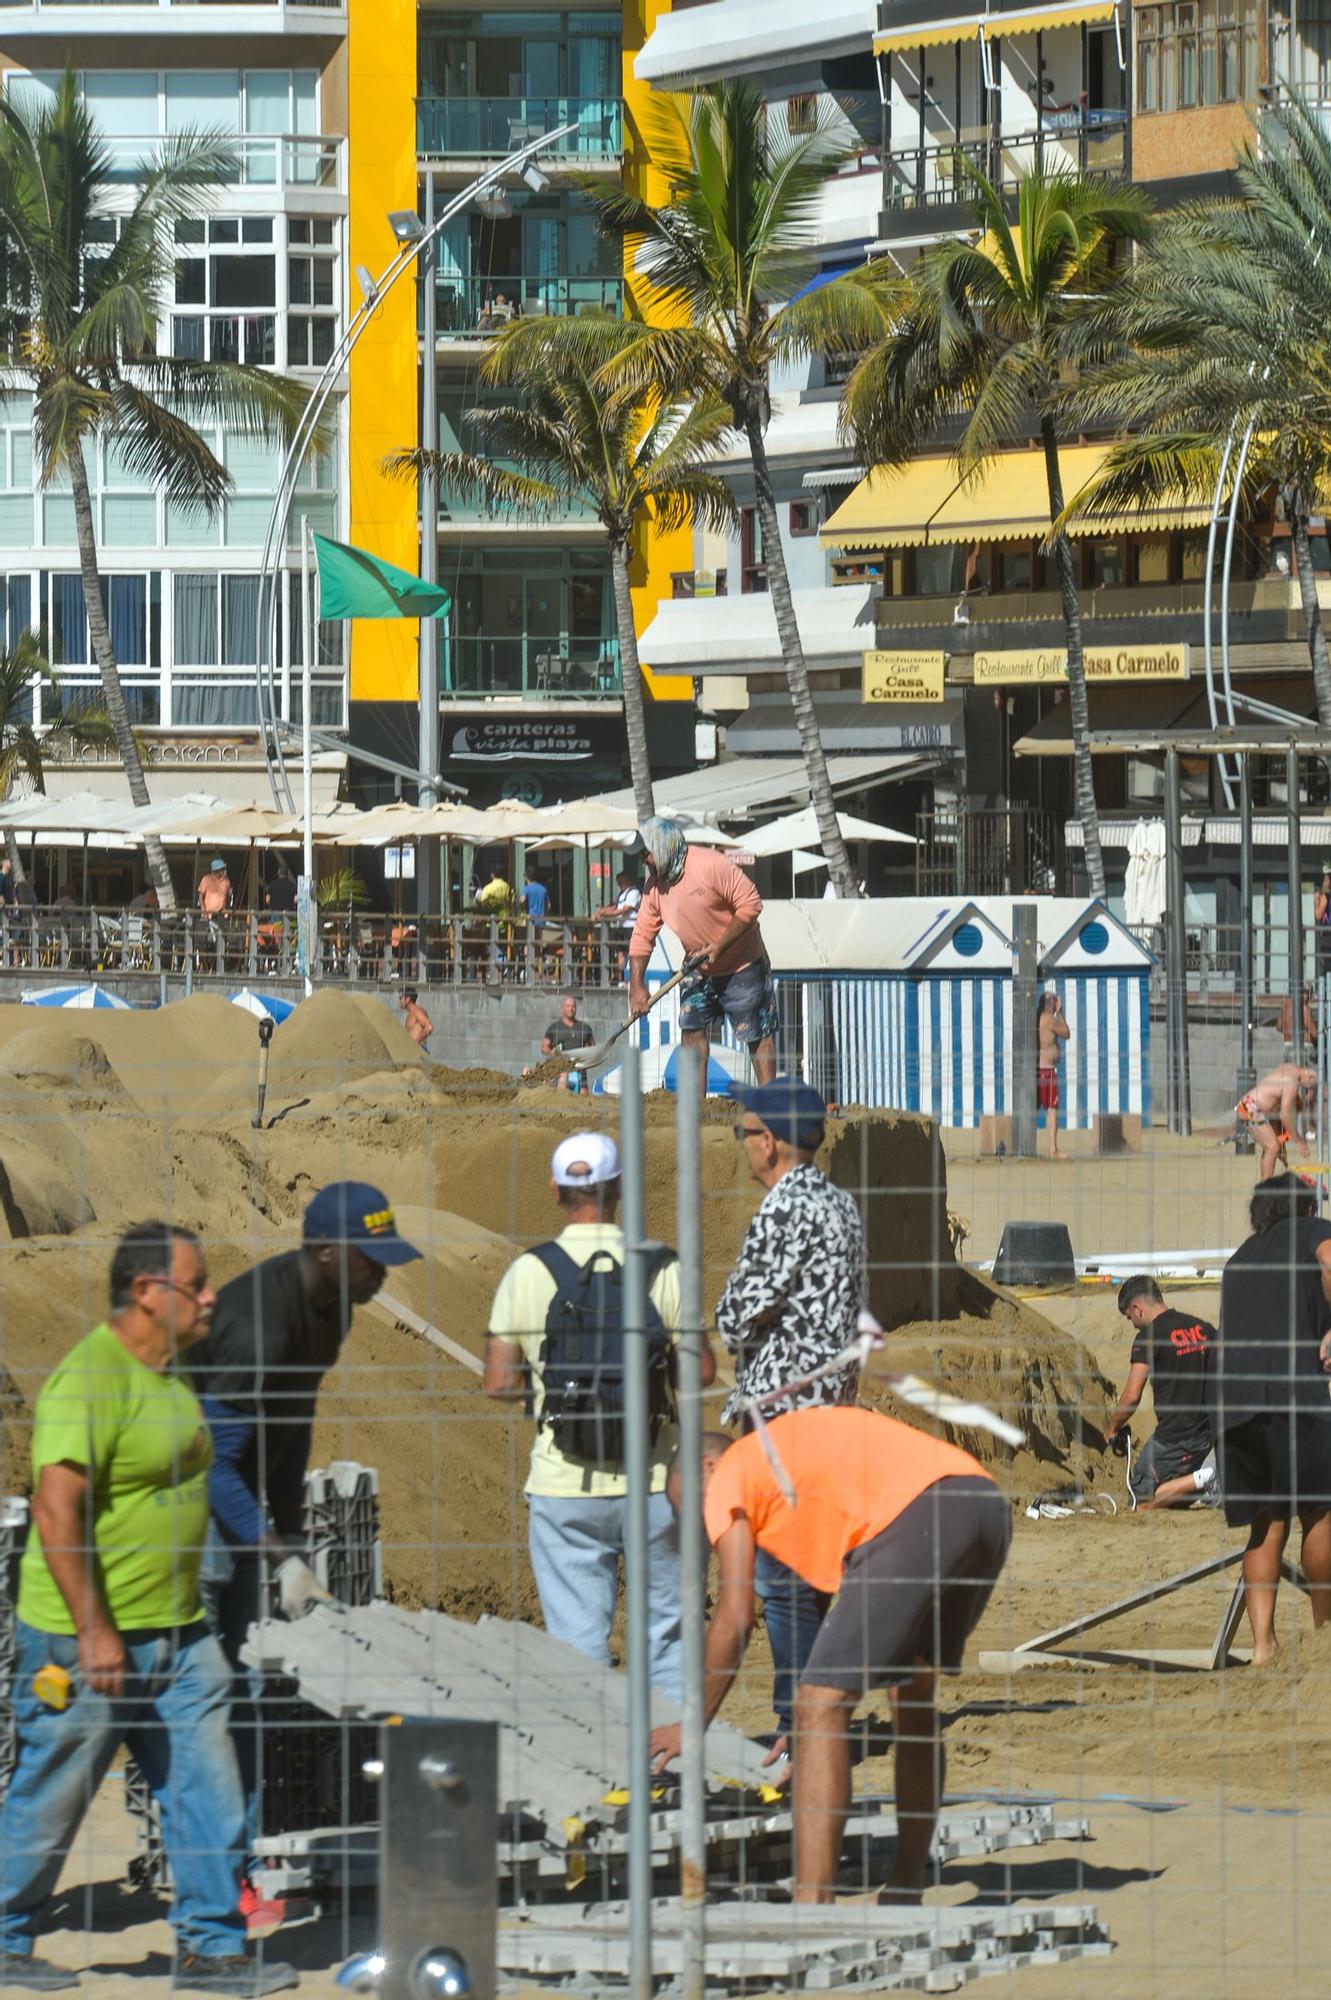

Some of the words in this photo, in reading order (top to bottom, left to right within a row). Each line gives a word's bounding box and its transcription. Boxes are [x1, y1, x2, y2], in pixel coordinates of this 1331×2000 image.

[869, 654, 940, 664] Restaurante
[976, 656, 1034, 678] Restaurante
[1037, 654, 1062, 679] Grill
[1116, 651, 1180, 675] Carmelo
[891, 664, 920, 674] Grill
[885, 676, 924, 688] Casa
[871, 687, 939, 699] Carmelo
[483, 722, 577, 736] canteras
[913, 725, 941, 746] CAIRO
[474, 737, 530, 750] vista
[533, 738, 592, 751] playa
